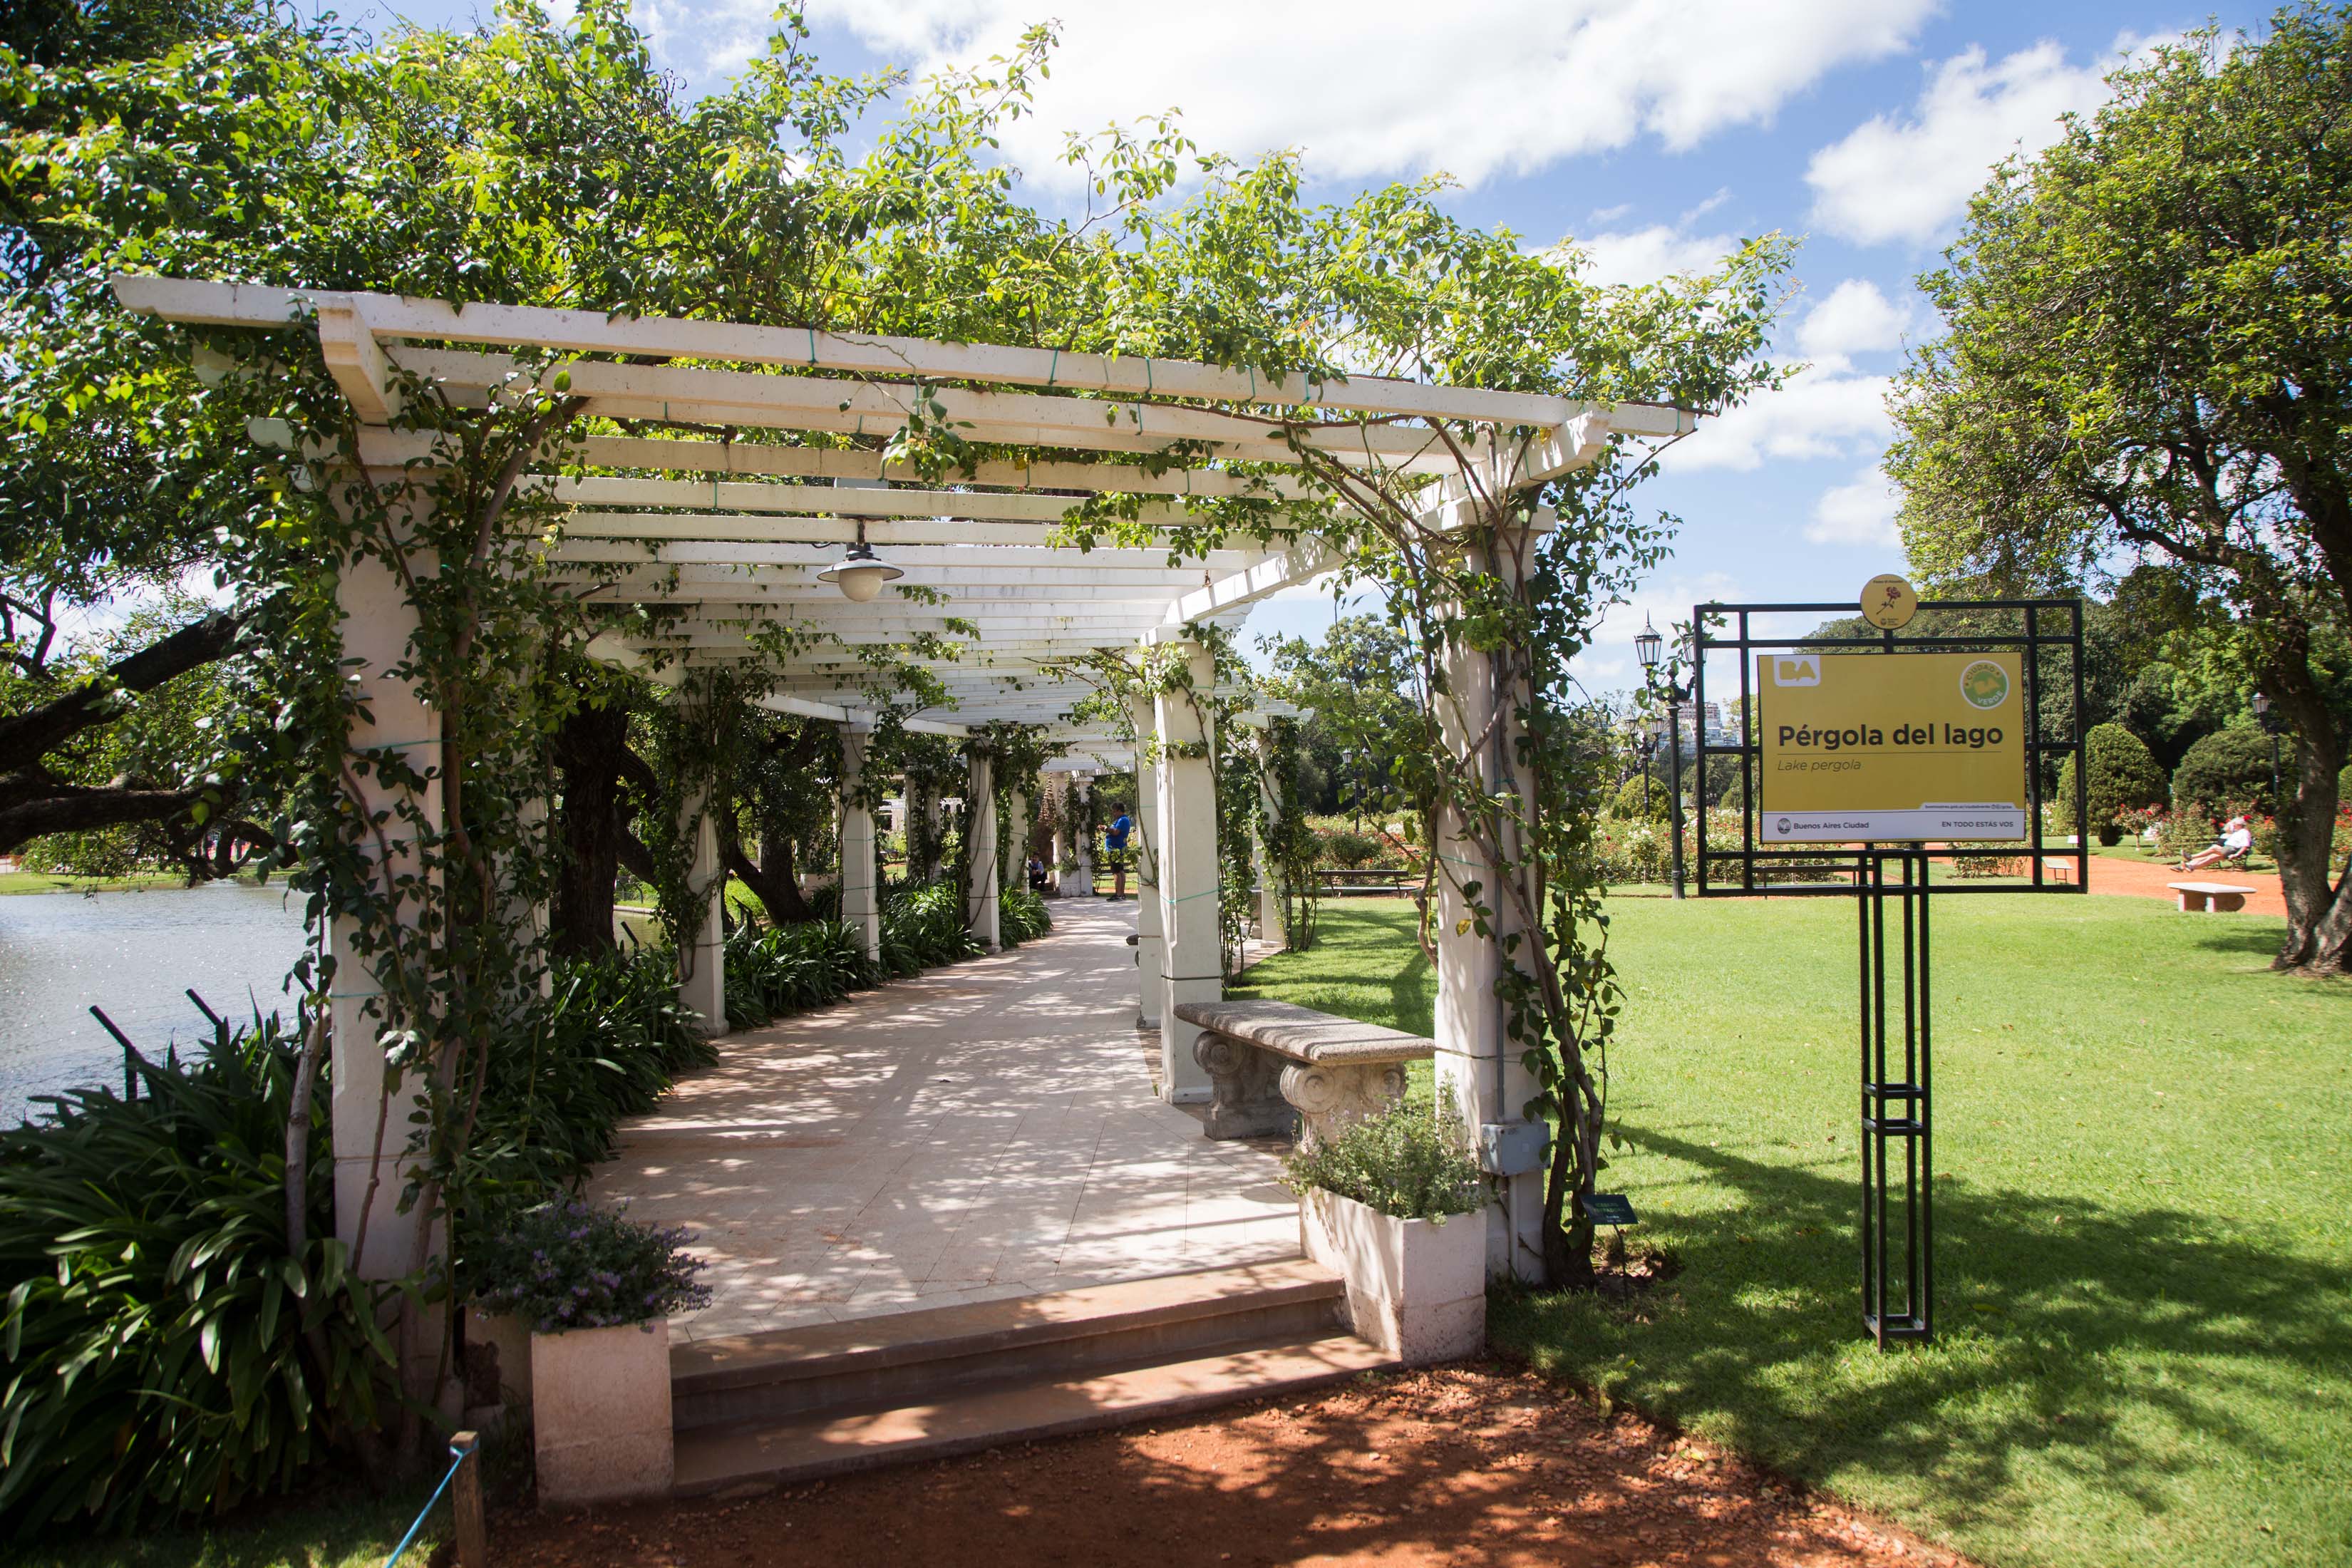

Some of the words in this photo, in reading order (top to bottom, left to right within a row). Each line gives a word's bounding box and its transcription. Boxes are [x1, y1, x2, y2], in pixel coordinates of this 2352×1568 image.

[1967, 664, 1996, 680] CIUDAD
[1979, 691, 2003, 705] VERDE
[1778, 724, 1883, 751] Pérgola
[1893, 723, 1934, 745] del
[1944, 723, 2003, 748] lago
[1778, 760, 1807, 770] Lake
[1811, 759, 1862, 772] pergola
